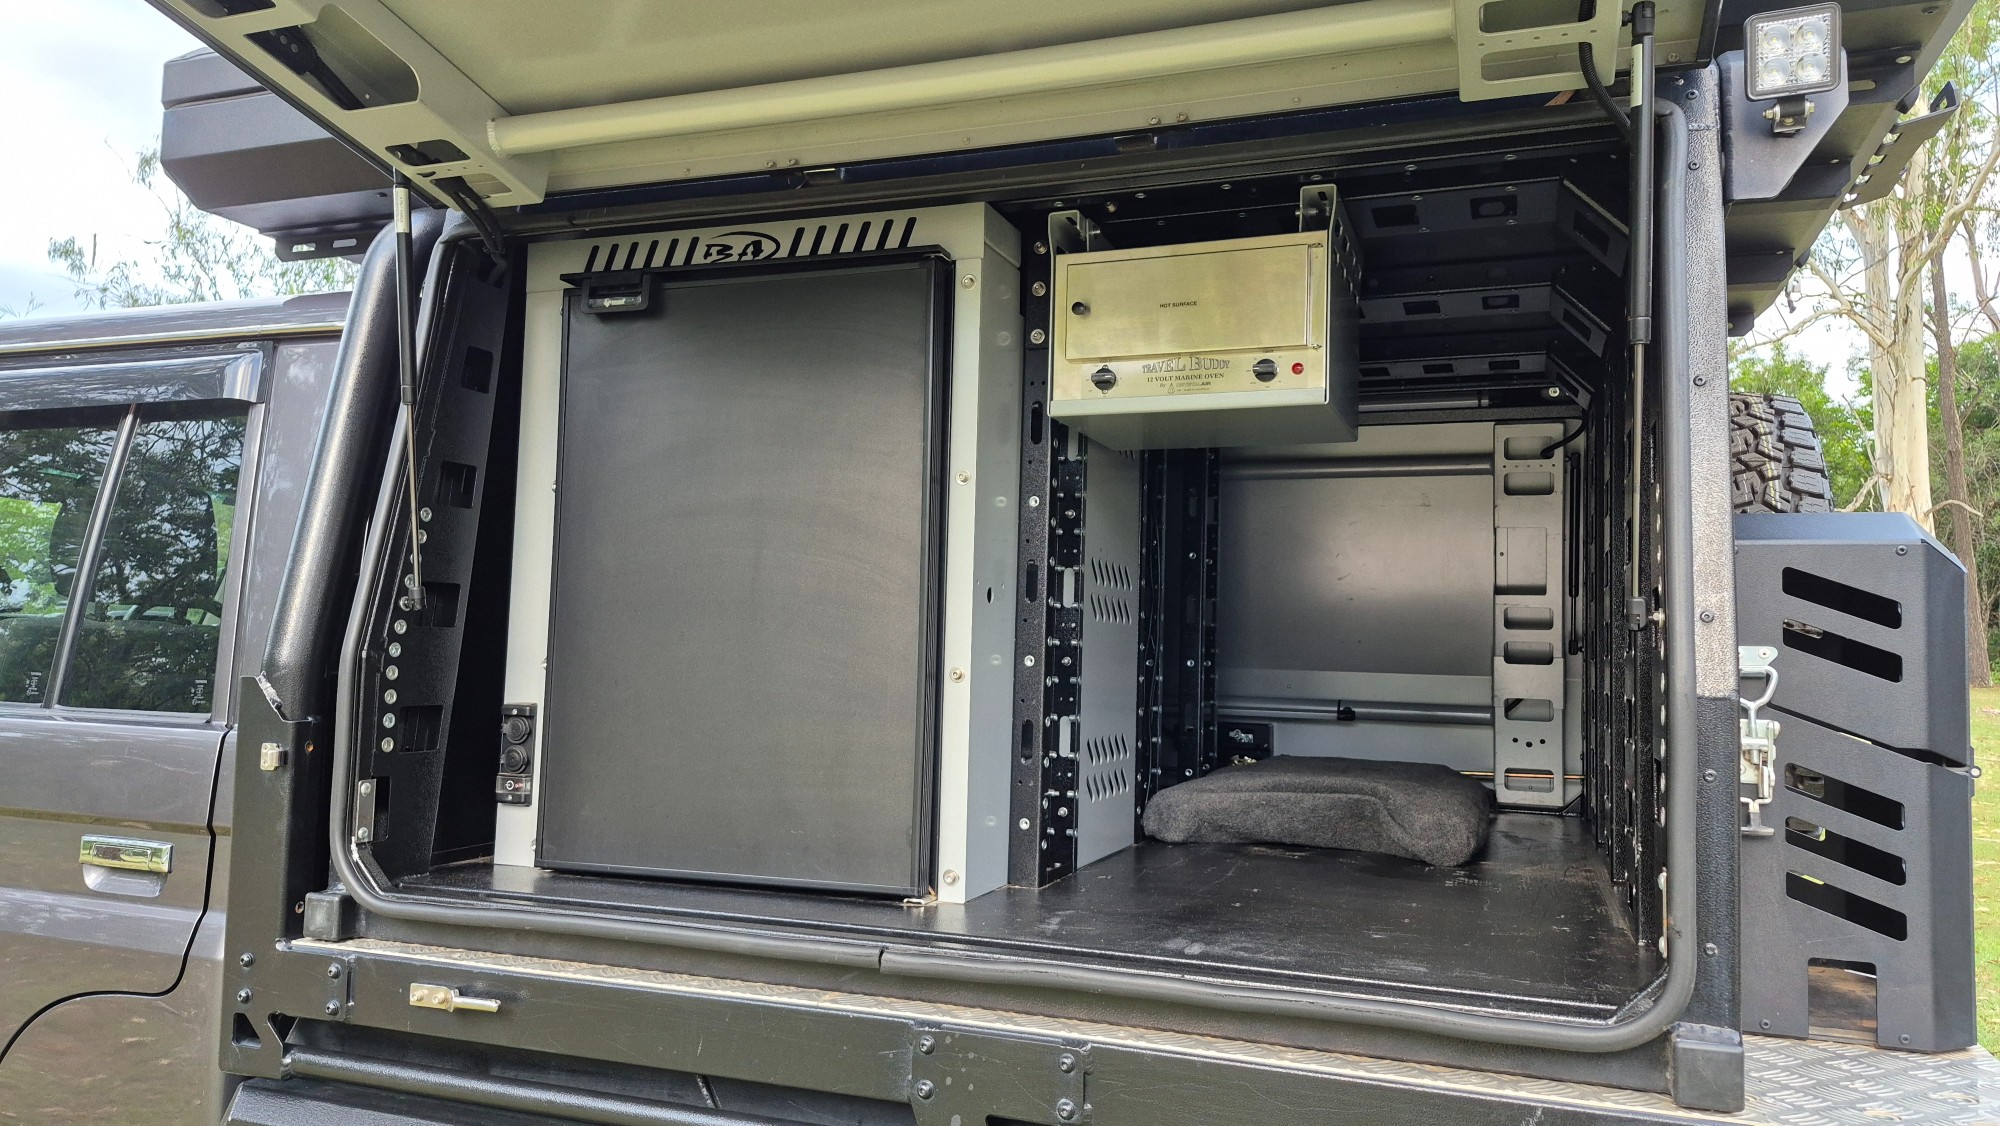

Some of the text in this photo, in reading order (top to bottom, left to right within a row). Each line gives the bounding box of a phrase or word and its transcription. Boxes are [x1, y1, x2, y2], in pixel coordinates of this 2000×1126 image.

[703, 239, 764, 263] BA
[1172, 300, 1198, 308] SURFACE
[1141, 356, 1231, 374] TRAVEL BUDDY
[1174, 373, 1203, 381] MARINE
[1204, 372, 1225, 380] OVEN
